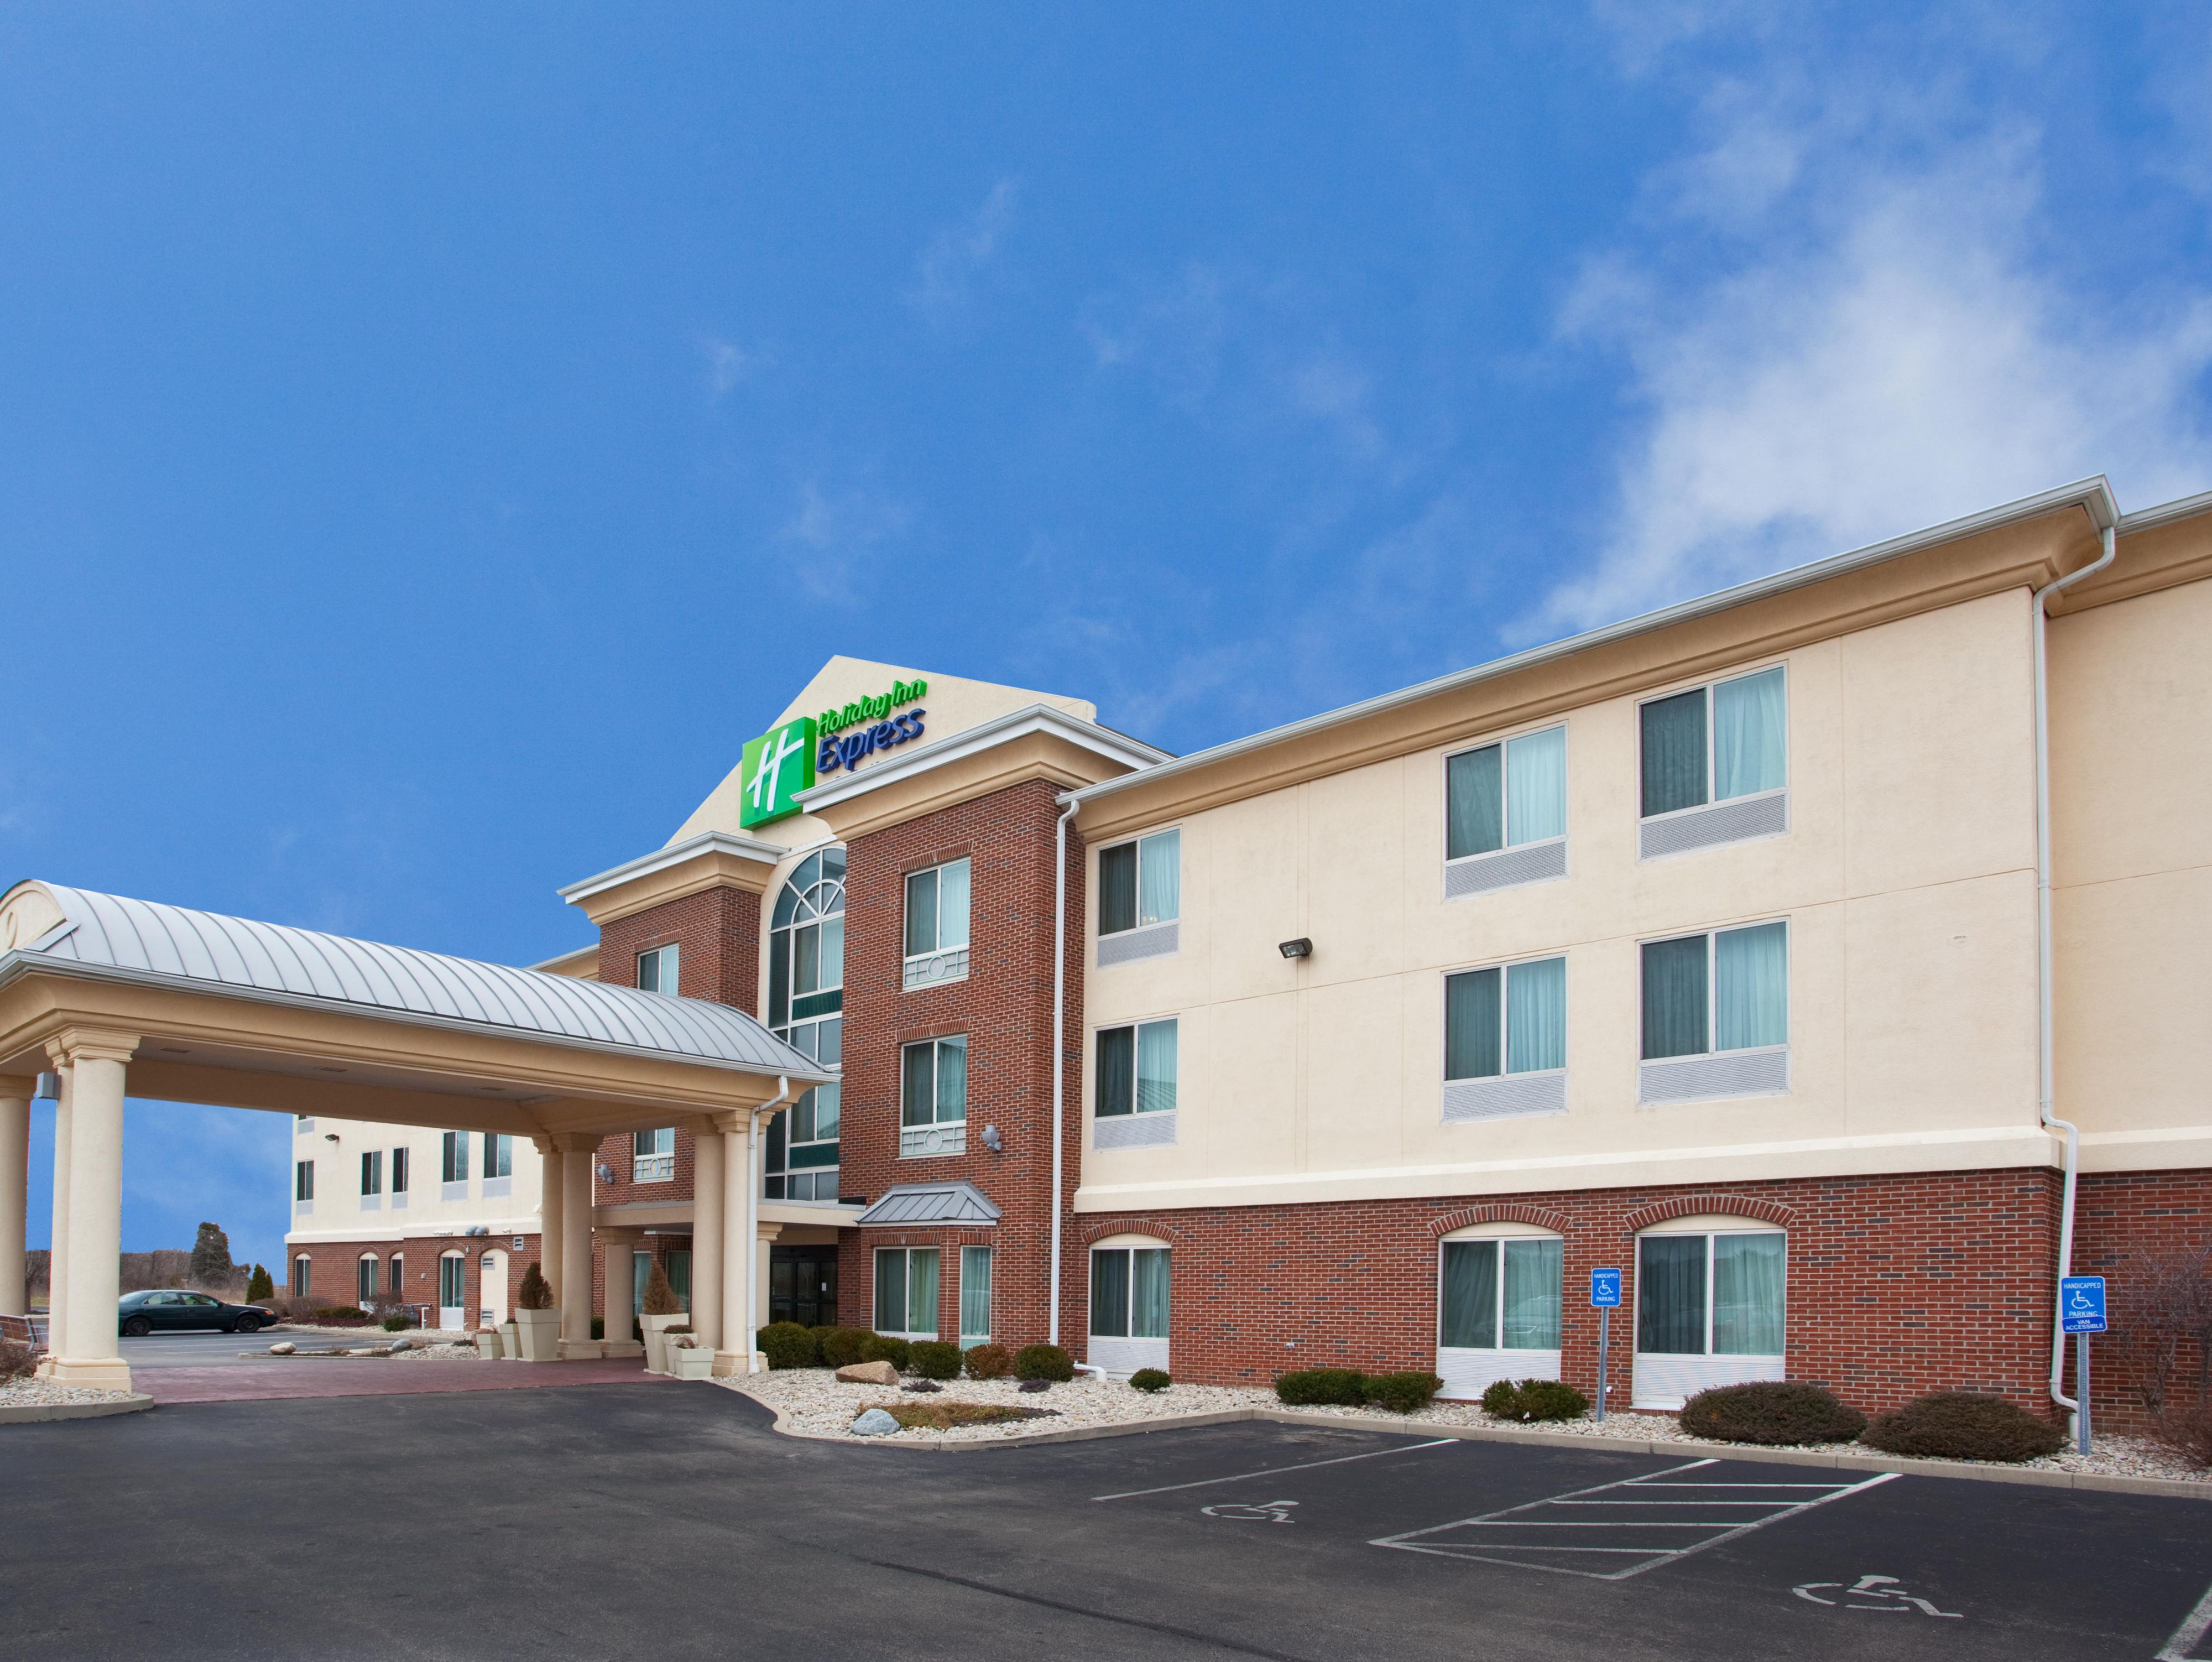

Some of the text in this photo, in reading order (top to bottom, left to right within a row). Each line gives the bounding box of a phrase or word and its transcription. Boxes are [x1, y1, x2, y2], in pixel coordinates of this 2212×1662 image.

[817, 679, 927, 738] Holiday Inn
[816, 708, 926, 773] Express
